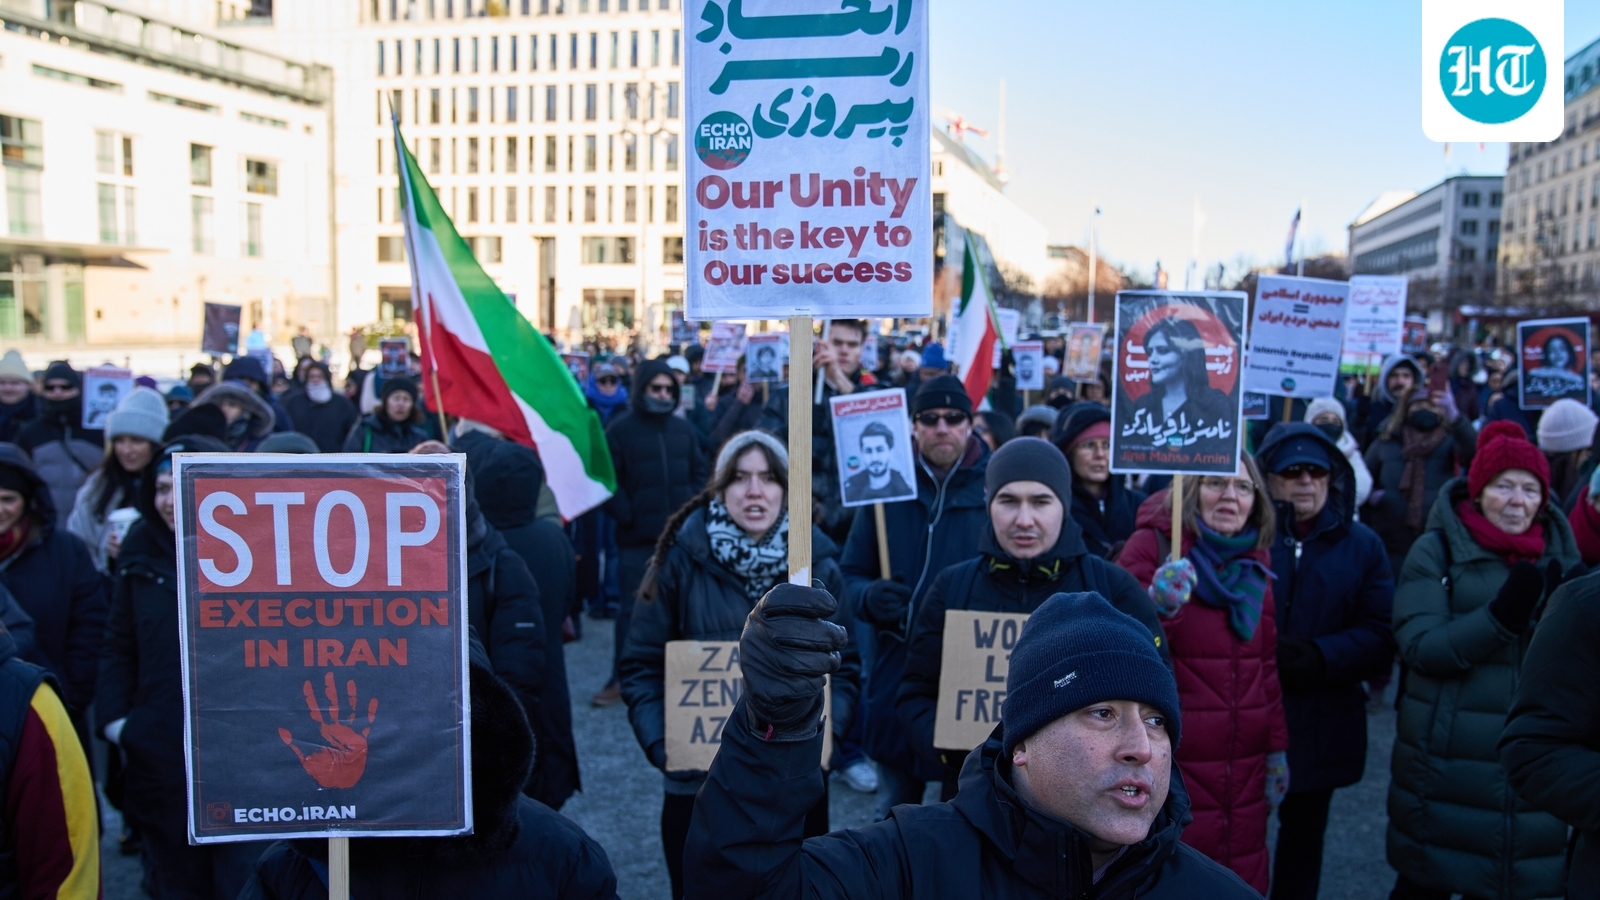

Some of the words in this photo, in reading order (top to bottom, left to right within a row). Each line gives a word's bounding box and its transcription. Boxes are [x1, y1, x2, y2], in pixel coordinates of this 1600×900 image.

[708, 42, 914, 95] رمز
[701, 123, 749, 137] ECHO
[752, 85, 914, 147] پیروزی
[709, 137, 751, 150] IRAN
[696, 175, 783, 210] Our
[790, 166, 918, 218] Unity
[698, 220, 728, 251] is
[733, 222, 794, 250] the
[800, 221, 869, 258] key
[873, 221, 912, 247] to
[703, 260, 767, 286] Our
[771, 261, 912, 284] success
[1121, 450, 1146, 462] Jina
[1149, 450, 1190, 464] Mahsa
[1193, 452, 1231, 464] Amini
[198, 489, 441, 588] STOP
[200, 598, 449, 628] EXECUTION
[974, 618, 1027, 650] WO
[244, 639, 288, 668] IN
[303, 638, 408, 667] IRAN
[985, 654, 1010, 683] L
[678, 678, 744, 708] ZEN
[234, 805, 356, 823] ECHO.IRAN
